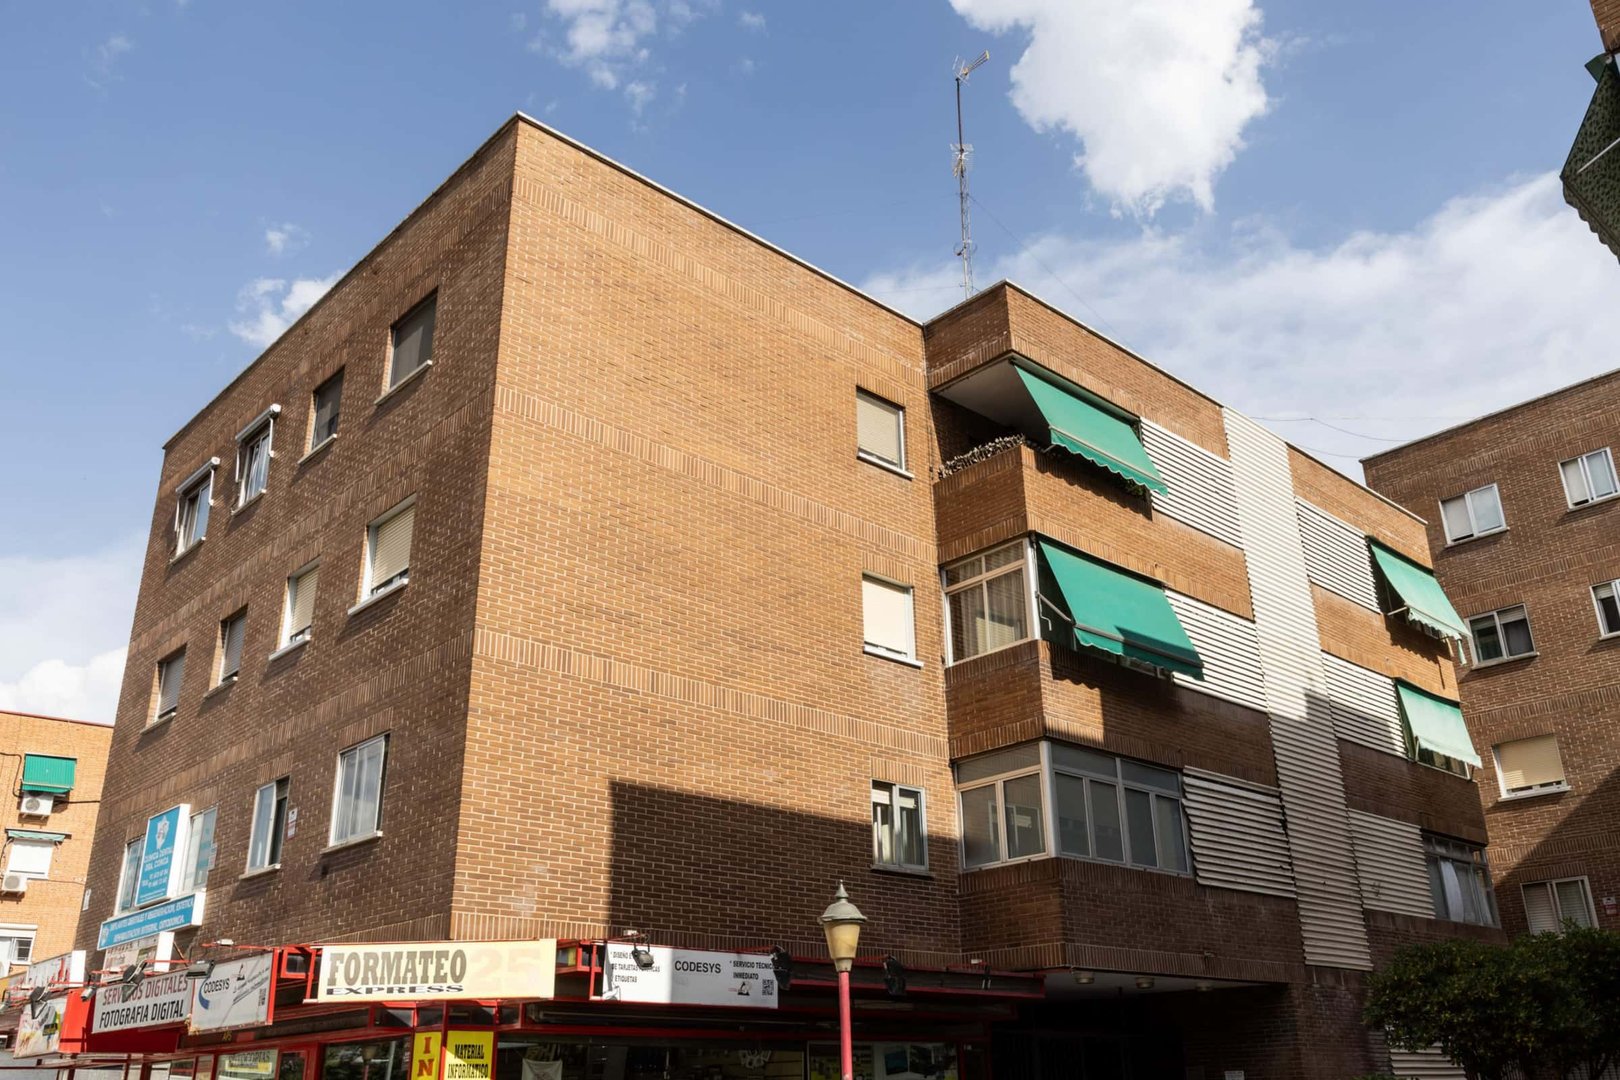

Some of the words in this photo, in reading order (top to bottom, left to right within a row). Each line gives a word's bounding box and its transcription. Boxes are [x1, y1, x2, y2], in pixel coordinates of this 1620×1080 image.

[327, 949, 467, 986] FORMATEO
[674, 960, 722, 974] CODESYS
[733, 960, 755, 968] SERVICIO
[614, 975, 638, 983] ETIQUETAS
[733, 971, 759, 980] INMEDIATO
[103, 982, 144, 1006] SERVOS
[145, 974, 189, 999] DIGITALES
[203, 977, 230, 994] CODESYS
[326, 984, 464, 995] EXPRESS
[99, 1005, 149, 1029] FOTOGRAFIA
[150, 999, 184, 1021] DIGITAL
[454, 1043, 485, 1059] MATERIAL
